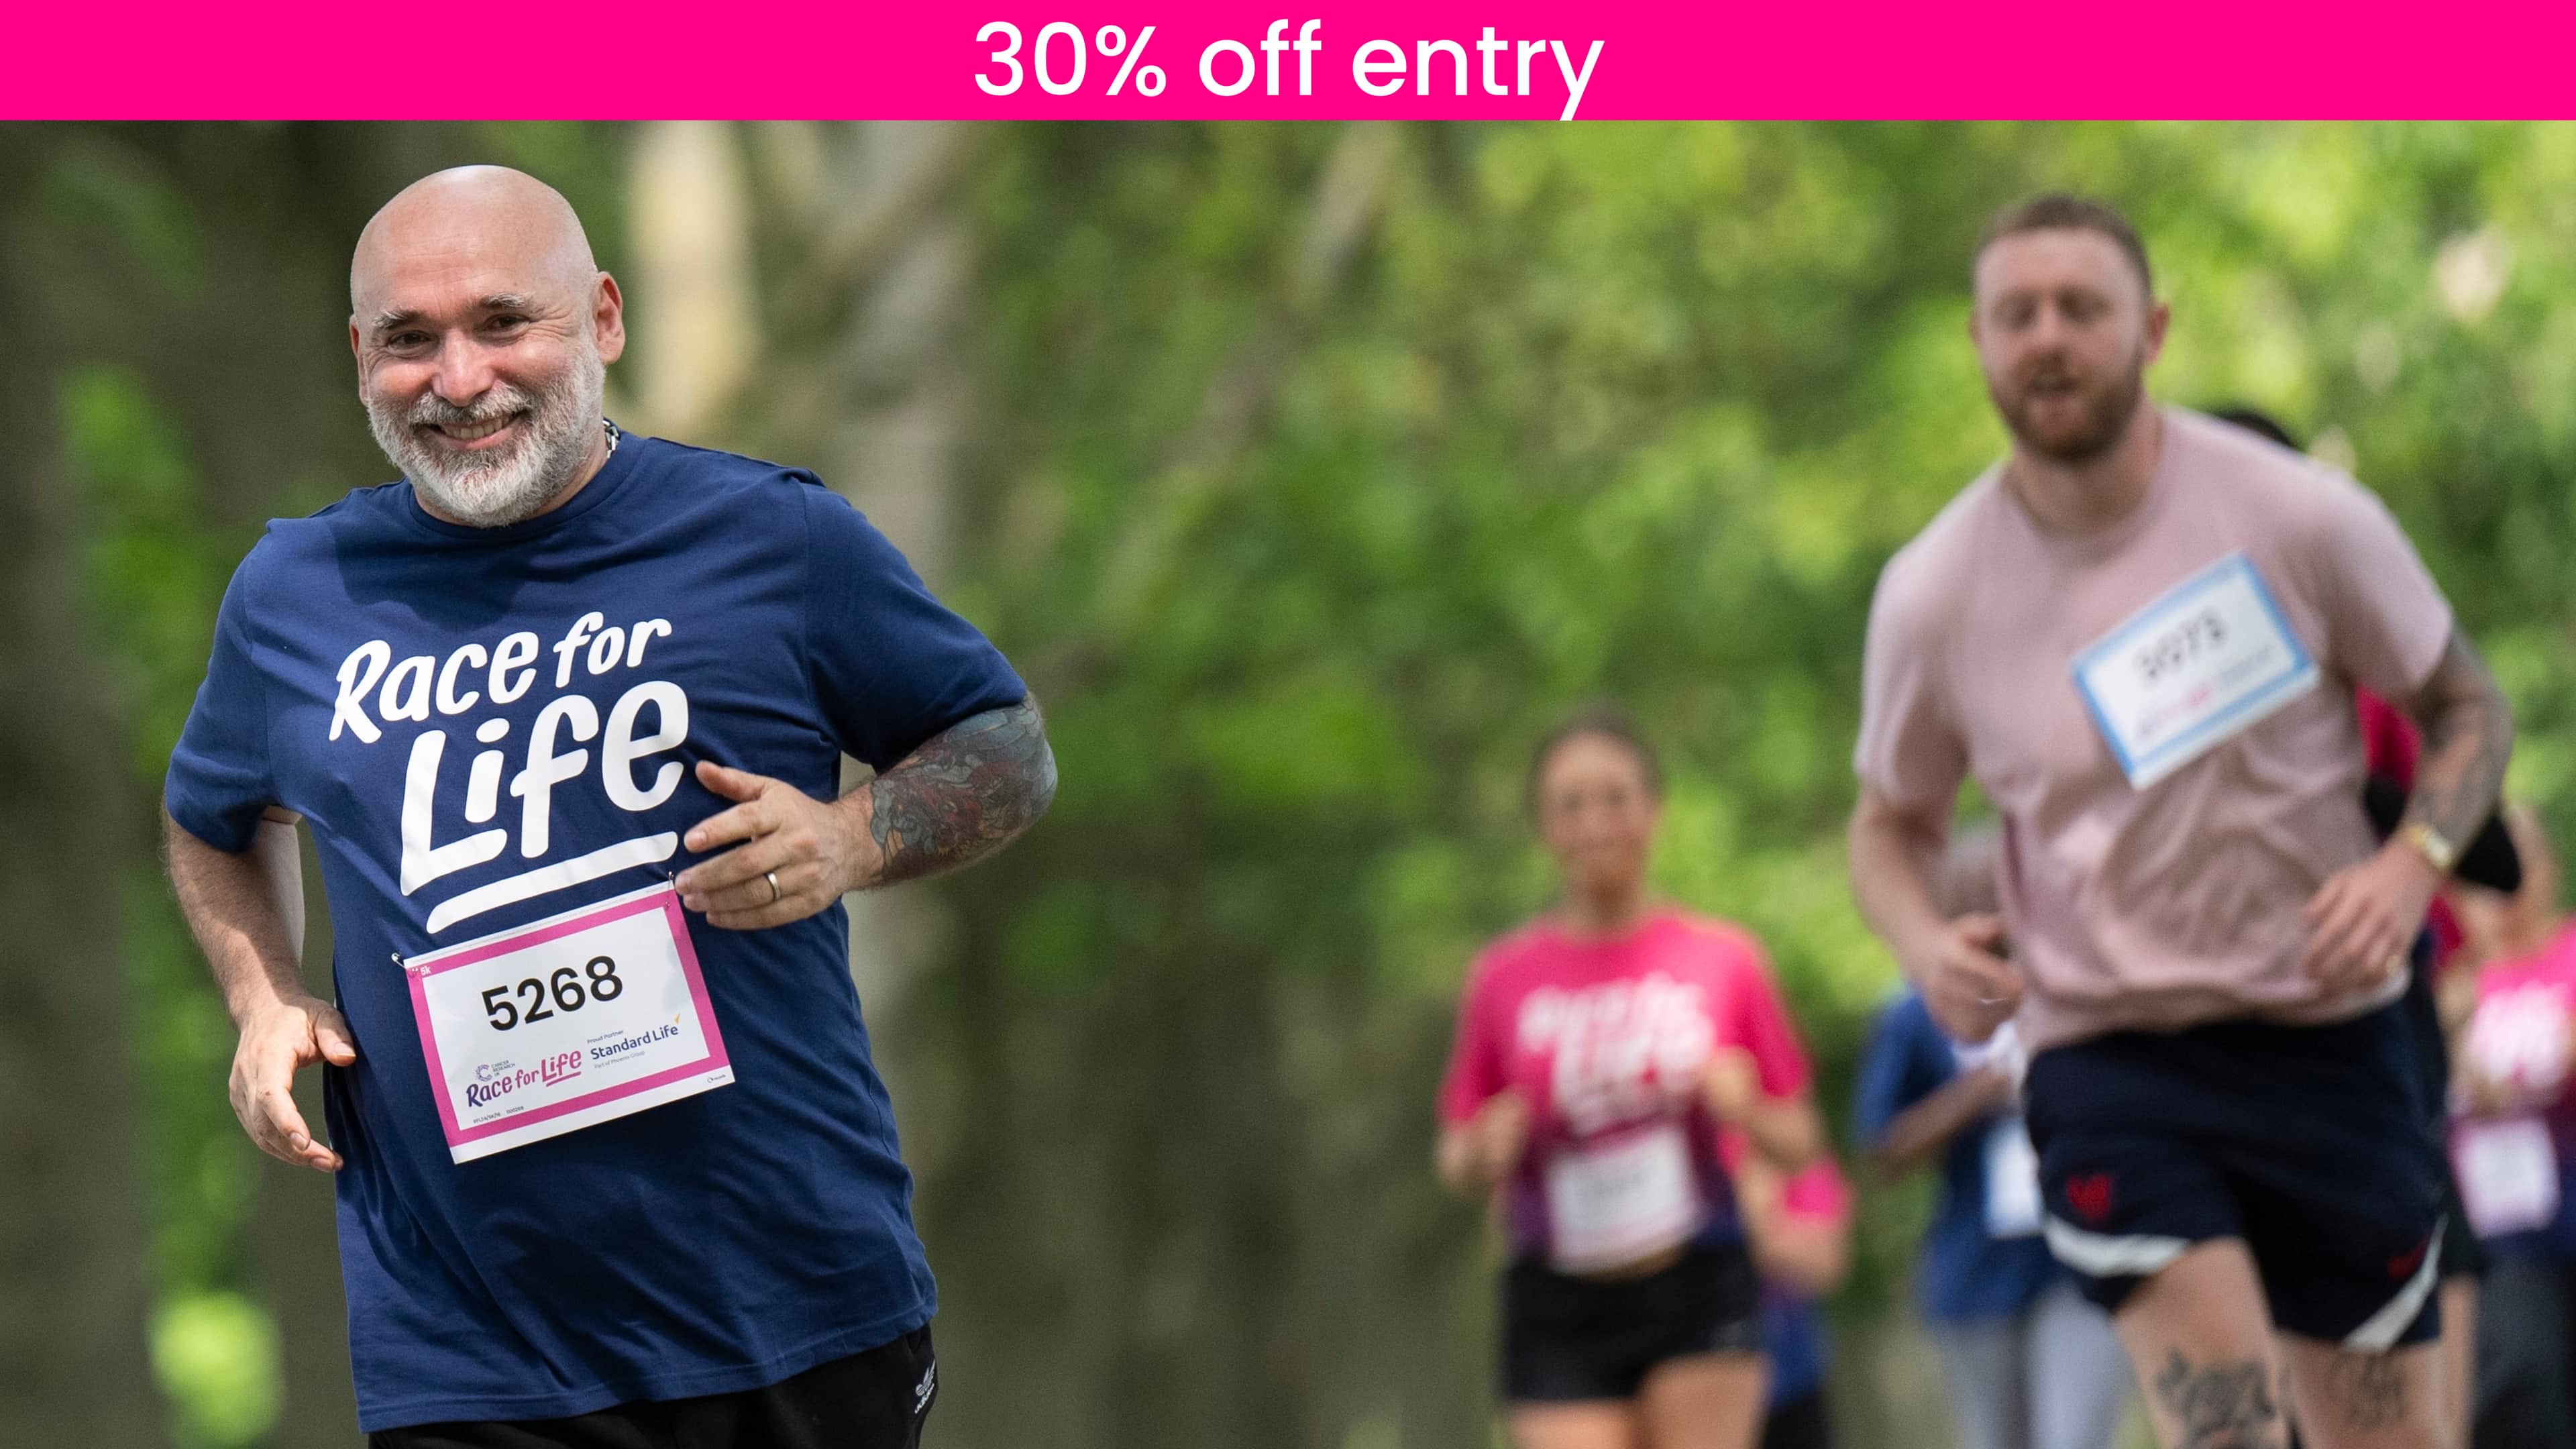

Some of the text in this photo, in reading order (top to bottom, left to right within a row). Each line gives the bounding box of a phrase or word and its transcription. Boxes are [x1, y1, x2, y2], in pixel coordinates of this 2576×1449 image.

[329, 611, 672, 744] Race for
[400, 680, 689, 896] Life
[482, 955, 623, 1032] 5268
[586, 1030, 624, 1044] Proud Partner
[590, 1024, 679, 1060] Standard Life
[466, 1051, 582, 1108] Race for Life
[491, 1060, 509, 1068] CANCER
[493, 1063, 516, 1073] RESEARCH
